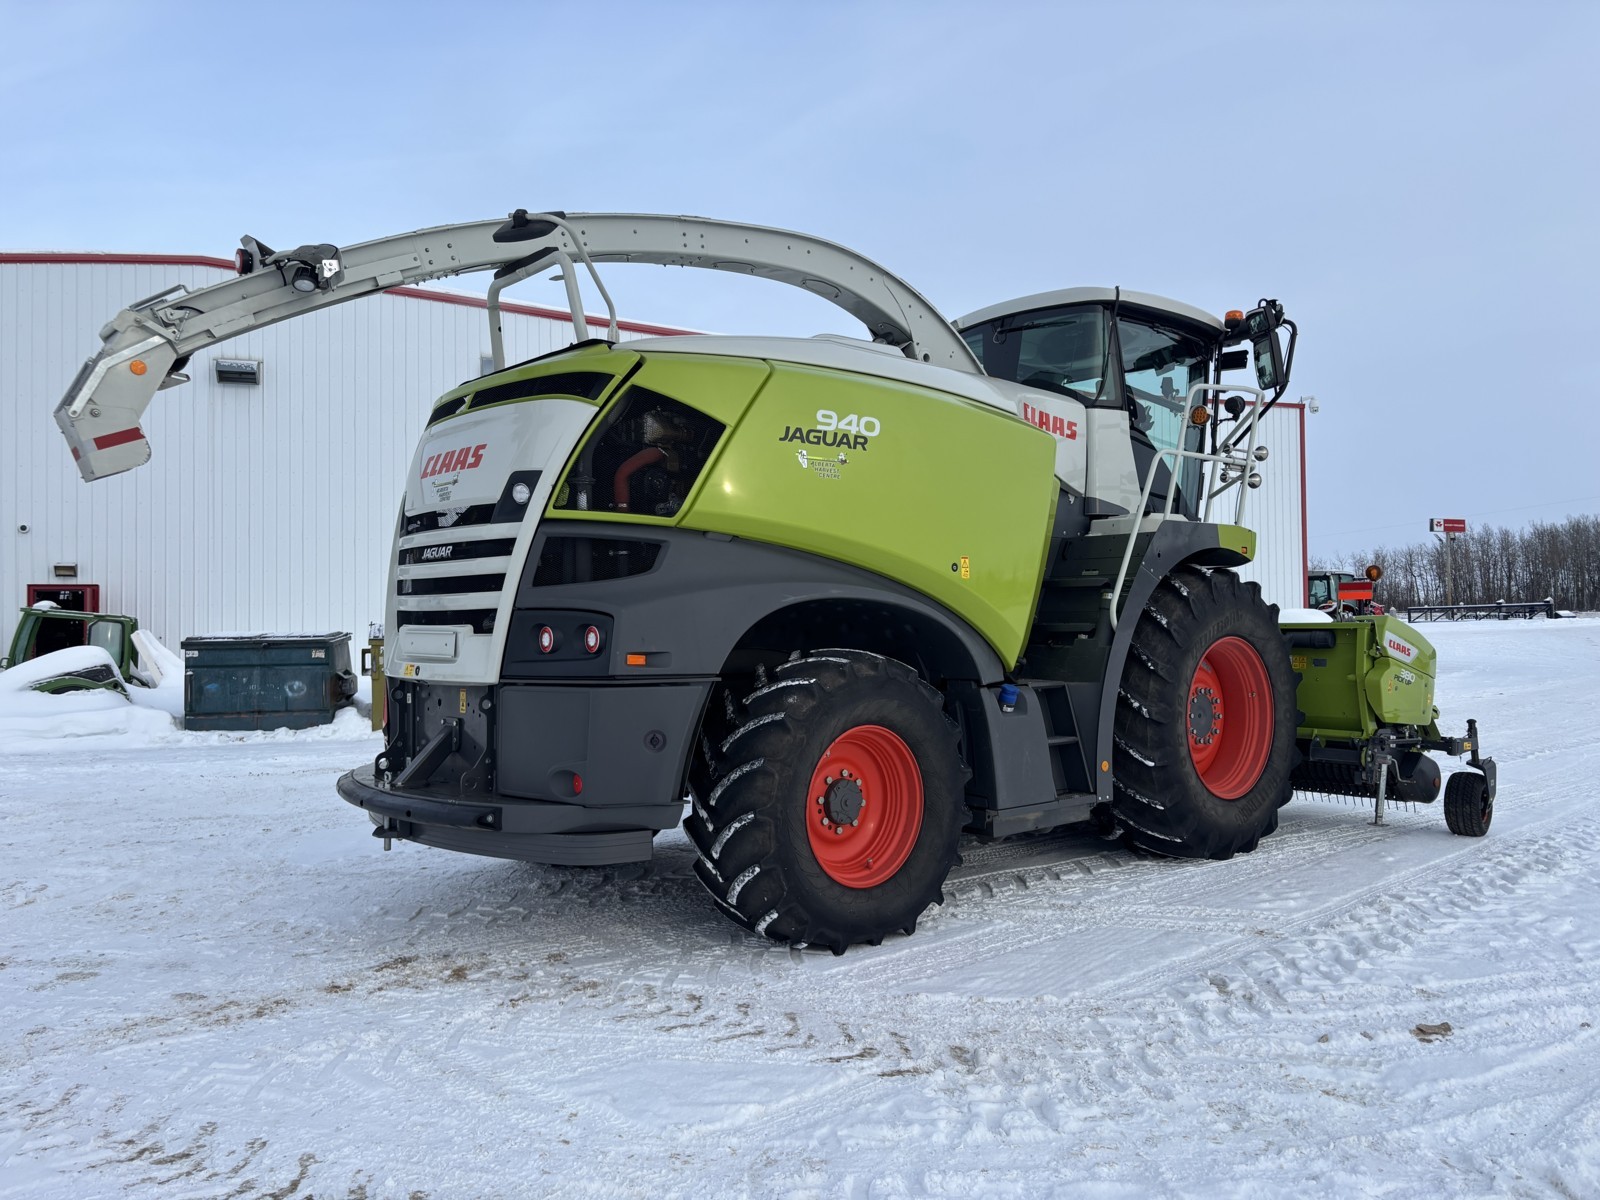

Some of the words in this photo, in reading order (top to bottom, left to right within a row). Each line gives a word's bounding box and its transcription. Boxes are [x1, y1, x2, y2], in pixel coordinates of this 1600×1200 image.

[816, 409, 881, 437] 940
[1023, 402, 1078, 441] CLAAS
[778, 425, 869, 452] JAGUAR
[420, 443, 488, 480] CLAAS
[421, 545, 453, 560] JAGUAR
[1388, 639, 1412, 657] CLAAS
[1400, 668, 1416, 683] 380
